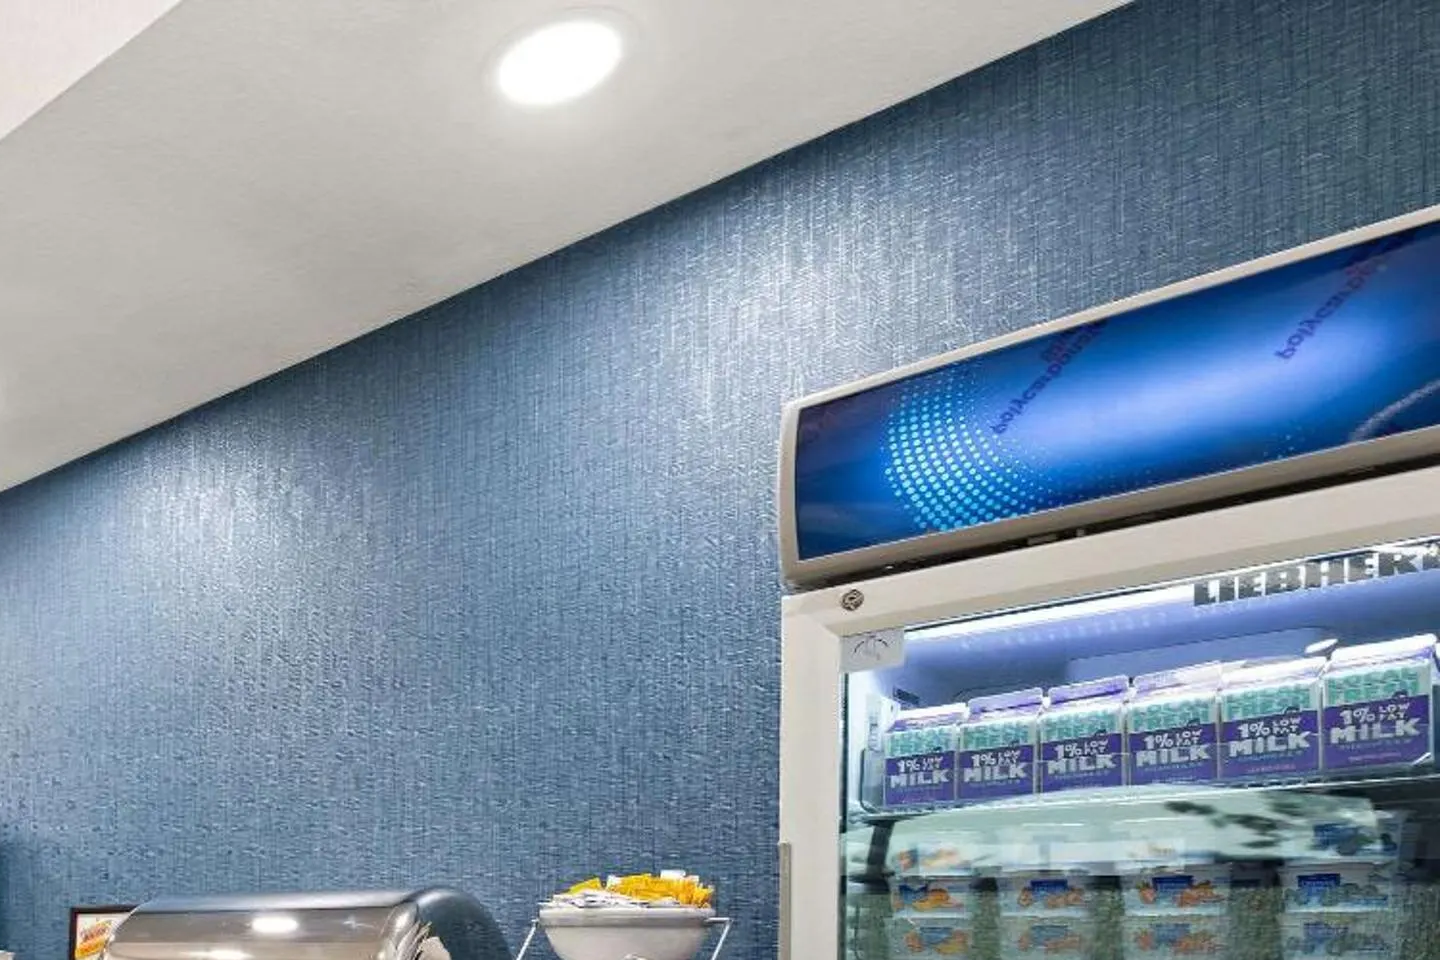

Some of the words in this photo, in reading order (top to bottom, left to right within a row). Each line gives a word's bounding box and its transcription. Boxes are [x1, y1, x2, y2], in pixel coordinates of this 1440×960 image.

[1340, 706, 1375, 725] 1%
[1379, 703, 1410, 713] LOW
[1380, 711, 1405, 720] FAT
[1238, 720, 1270, 738] 1%
[1330, 718, 1421, 744] MILK
[1055, 742, 1081, 758] 1%
[1144, 732, 1173, 750] 1%
[1229, 731, 1310, 757] MILK
[971, 752, 996, 768] 1%
[1048, 753, 1117, 775] MILK
[1136, 744, 1210, 767] MILK
[897, 760, 920, 773] 1%
[964, 761, 1027, 784] MILK
[890, 768, 949, 788] MILK
